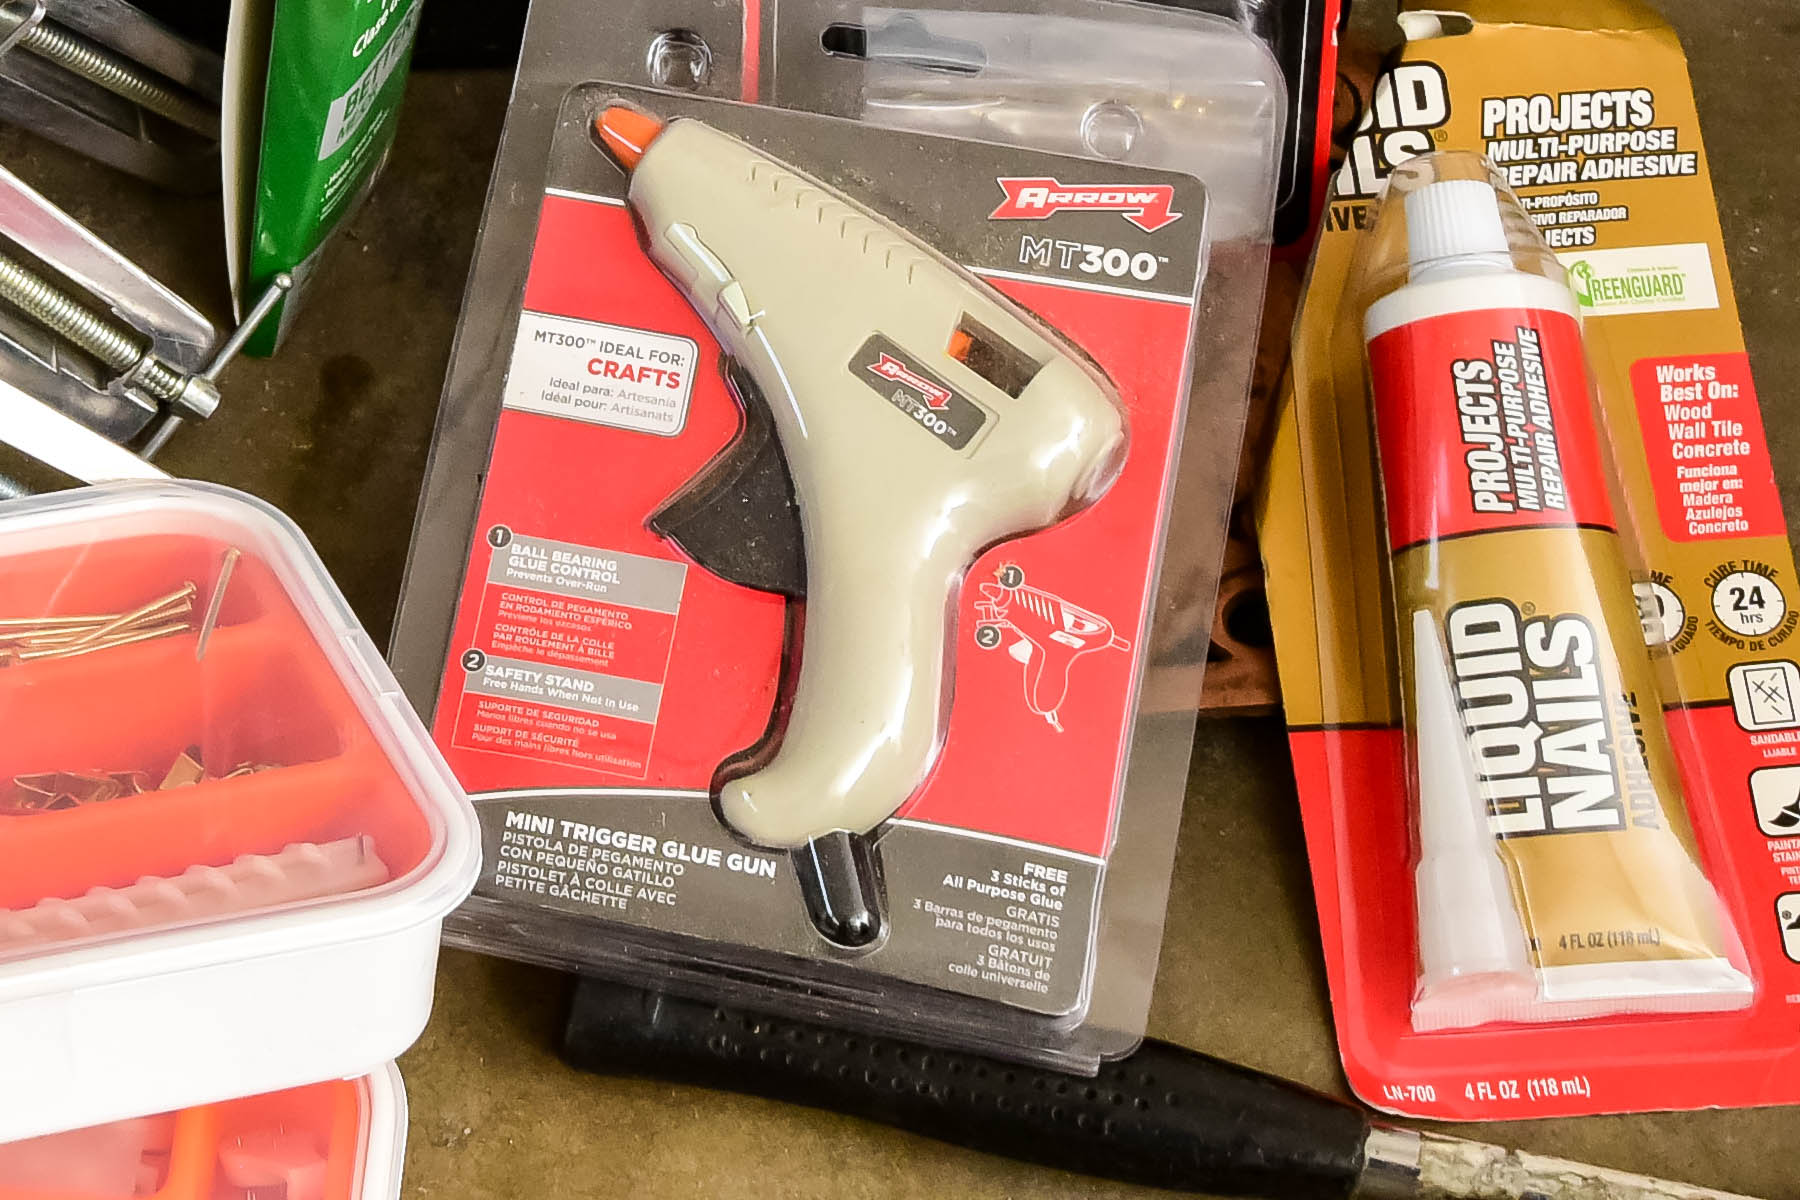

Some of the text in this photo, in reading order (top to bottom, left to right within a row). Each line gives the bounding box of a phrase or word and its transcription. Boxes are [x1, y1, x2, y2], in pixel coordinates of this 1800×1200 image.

[352, 8, 389, 58] Clase
[1482, 88, 1654, 138] PROJECTS
[1487, 128, 1676, 163] MULTI-PURPOSE
[1580, 152, 1697, 180] ADHESIVE
[1015, 187, 1160, 208] ARROW
[1558, 206, 1628, 225] REPARADOR
[599, 340, 645, 360] IDEAL
[649, 350, 686, 367] FOR:
[587, 357, 681, 389] CRAFTS
[1656, 363, 1716, 383] Works
[549, 376, 614, 398] Ideal para:
[1660, 381, 1739, 402] Best On:
[574, 396, 673, 422] pour: Artisanats
[1516, 326, 1567, 511] REPAIR ADHESIVE
[1664, 402, 1712, 421] Wood
[1450, 358, 1517, 513] PROJECTS
[1491, 339, 1543, 511] MULTI-PURPOSE
[1668, 420, 1743, 440] Wall Tile
[1672, 439, 1751, 459] Concrete
[1677, 464, 1738, 479] Funciona
[1680, 478, 1743, 494] mejor en:
[1683, 492, 1733, 506] Madera
[1686, 505, 1743, 520] Azulejos
[1689, 519, 1749, 535] Concreto
[508, 555, 621, 585] GLUE CONTROL
[511, 543, 618, 571] BALL BEARING
[506, 567, 608, 593] Prevents Over-Run
[1703, 560, 1779, 589] CURE TIME
[501, 592, 629, 620] CONTROL PEGAMENTO
[1729, 585, 1766, 611] 24
[1705, 610, 1800, 650] TIEMPO CURADO
[1740, 612, 1764, 624] hrs
[483, 664, 595, 693] SAFETY STAND
[482, 677, 640, 712] Free Hands When Not Use
[1445, 597, 1547, 840] LIQUID
[1522, 613, 1627, 832] NAILS
[502, 831, 684, 876] PISTOLA DE PEGAMENTO
[505, 811, 777, 879] MINI TRIGGER GLUE GUN
[500, 845, 675, 888] CON PEQUEÑO GATILLO
[1023, 862, 1068, 884] FREE
[495, 874, 627, 910] PETITE GÂCHETTE
[497, 860, 676, 906] PISTOLET COLLE AVEC
[942, 874, 1063, 911] All Purpose Glue
[1003, 873, 1066, 897] Sticks of
[924, 901, 1058, 940] Barras pegamento
[967, 921, 1003, 940] todos
[1006, 906, 1060, 928] GRATIS
[1570, 933, 1585, 949] FL
[1587, 932, 1604, 948] OZ
[988, 944, 1053, 969] GRATUIT
[981, 971, 1049, 994] universelle
[1383, 1075, 1591, 1102] LN-700 4 FL OZ (118 mL)
